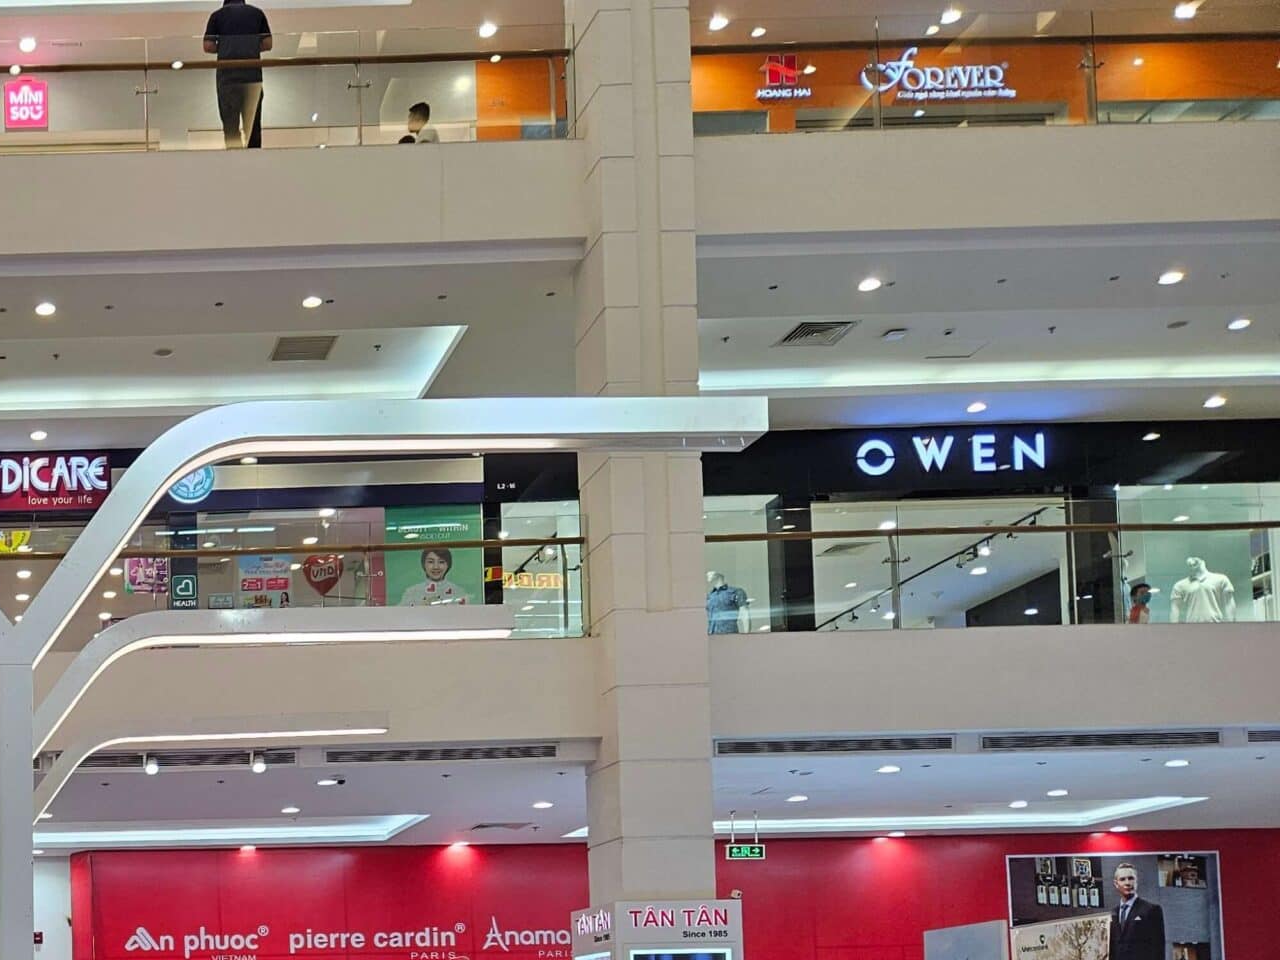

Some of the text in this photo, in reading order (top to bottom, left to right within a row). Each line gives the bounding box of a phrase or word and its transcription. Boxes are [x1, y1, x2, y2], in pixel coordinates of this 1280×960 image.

[9, 89, 43, 105] MINI
[856, 433, 1046, 476] OWEN
[28, 495, 92, 507] love your life
[629, 904, 728, 928] TÂN TÂN
[289, 928, 366, 954] pierre
[708, 930, 729, 938] 1985
[410, 951, 456, 960] PARIS
